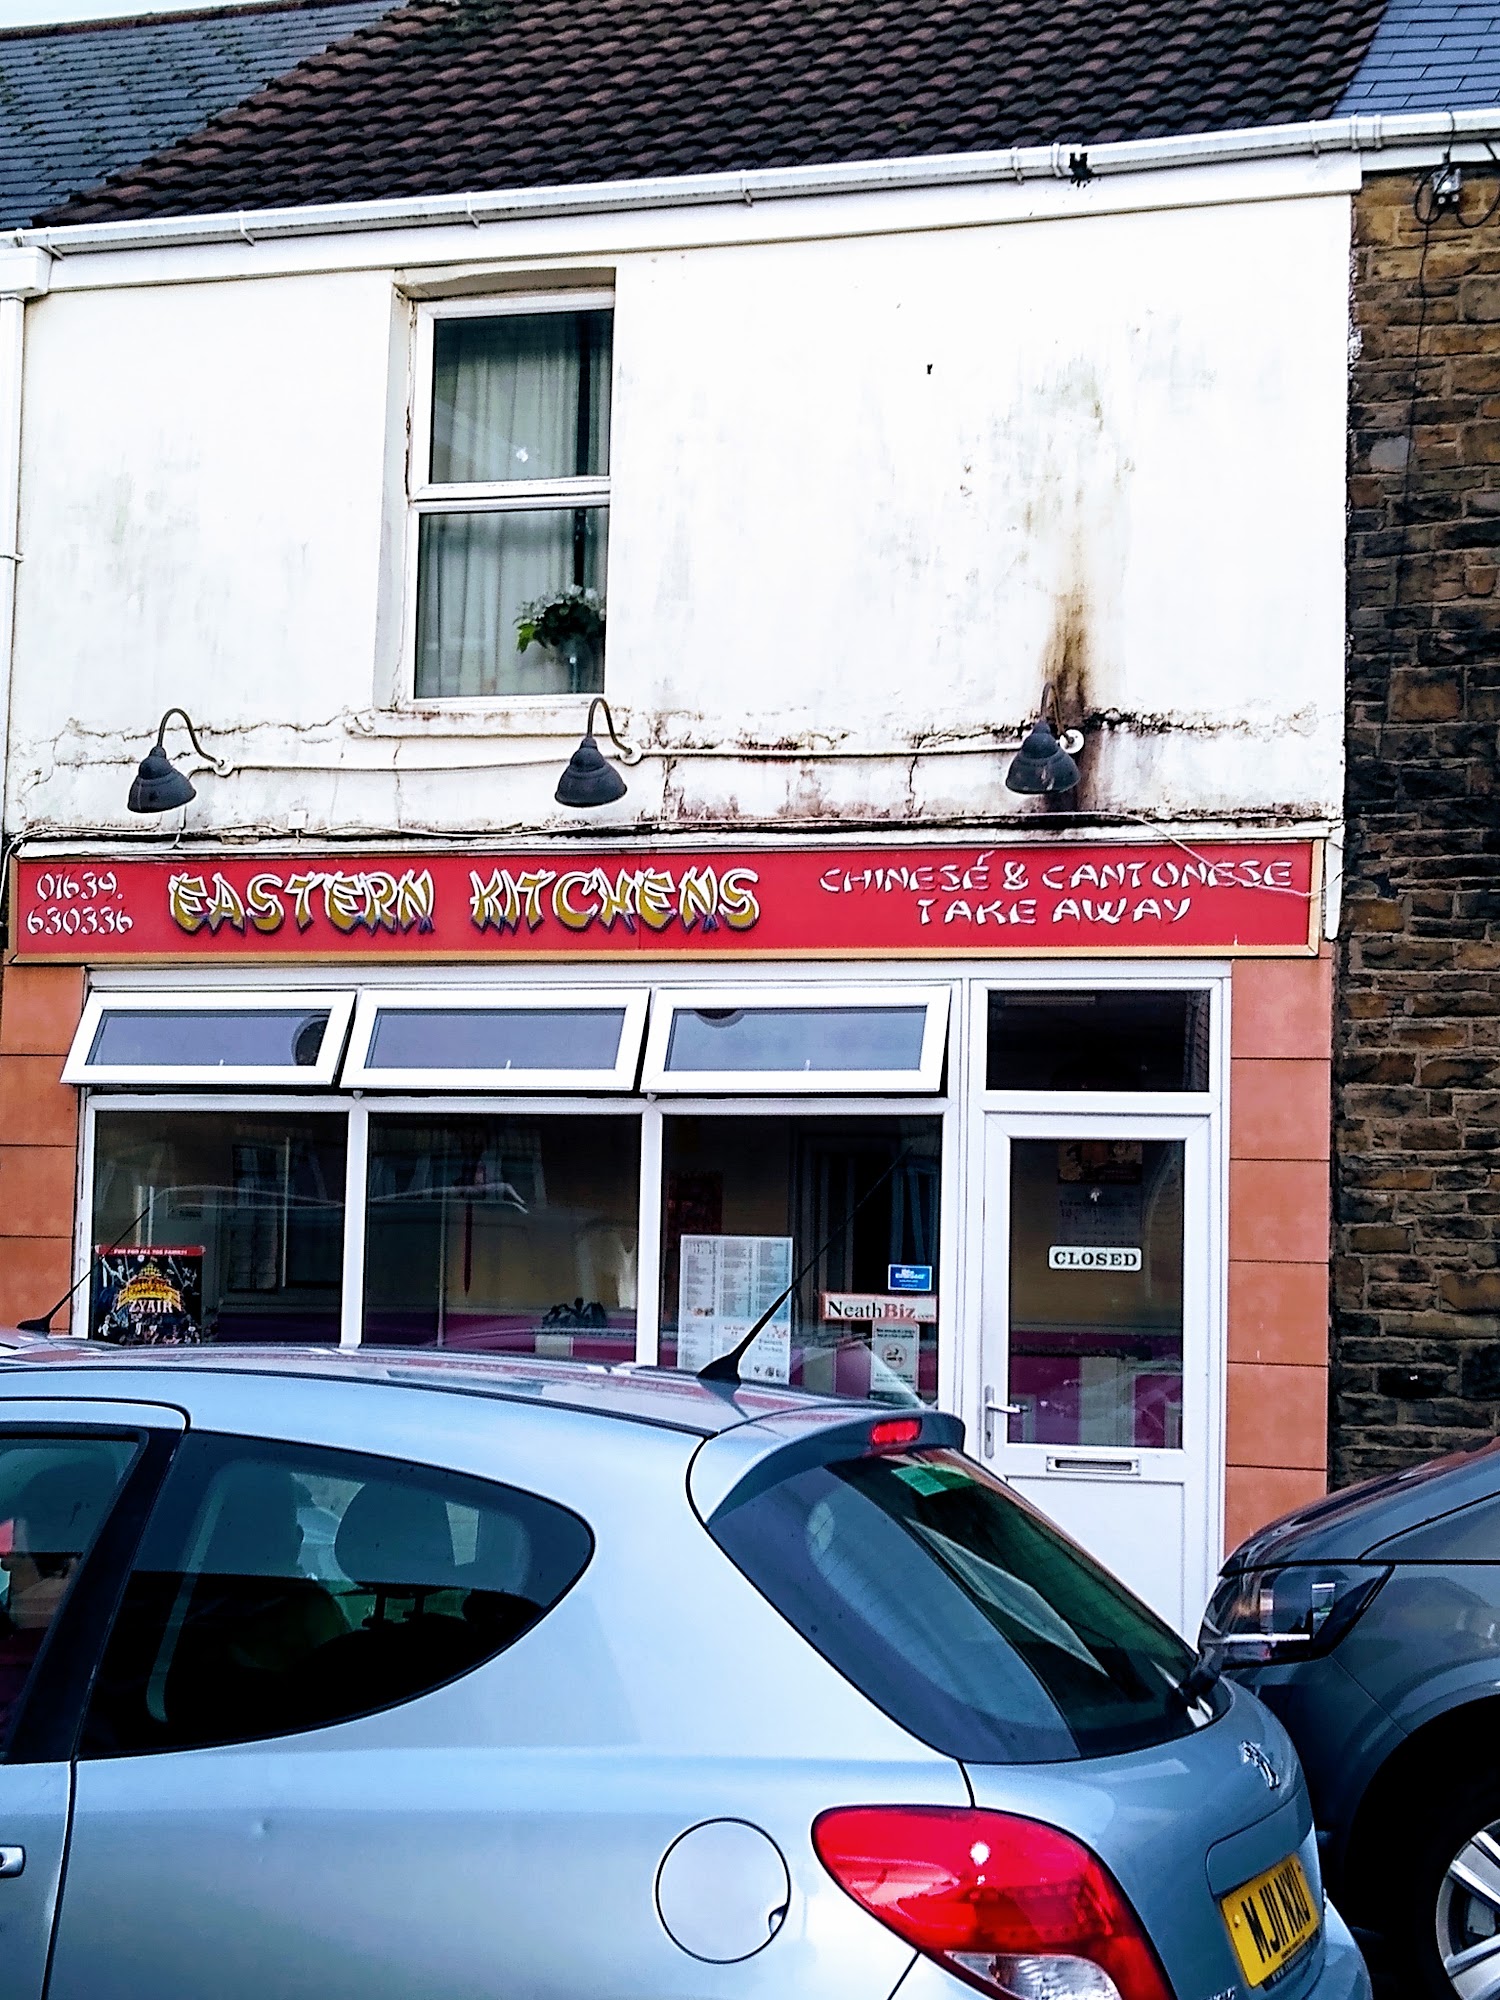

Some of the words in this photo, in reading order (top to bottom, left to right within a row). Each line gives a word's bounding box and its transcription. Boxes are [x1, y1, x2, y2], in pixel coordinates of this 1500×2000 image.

[1002, 860, 1030, 891] &
[1042, 858, 1294, 892] CANTONESE
[168, 868, 434, 935] EASTERN
[469, 866, 760, 935] KITCHENS
[917, 897, 1038, 927] TAKE
[1052, 897, 1192, 926] AWAY
[27, 905, 134, 936] 630336
[1053, 1251, 1138, 1268] CLOSED
[128, 1299, 174, 1314] ZYAIR
